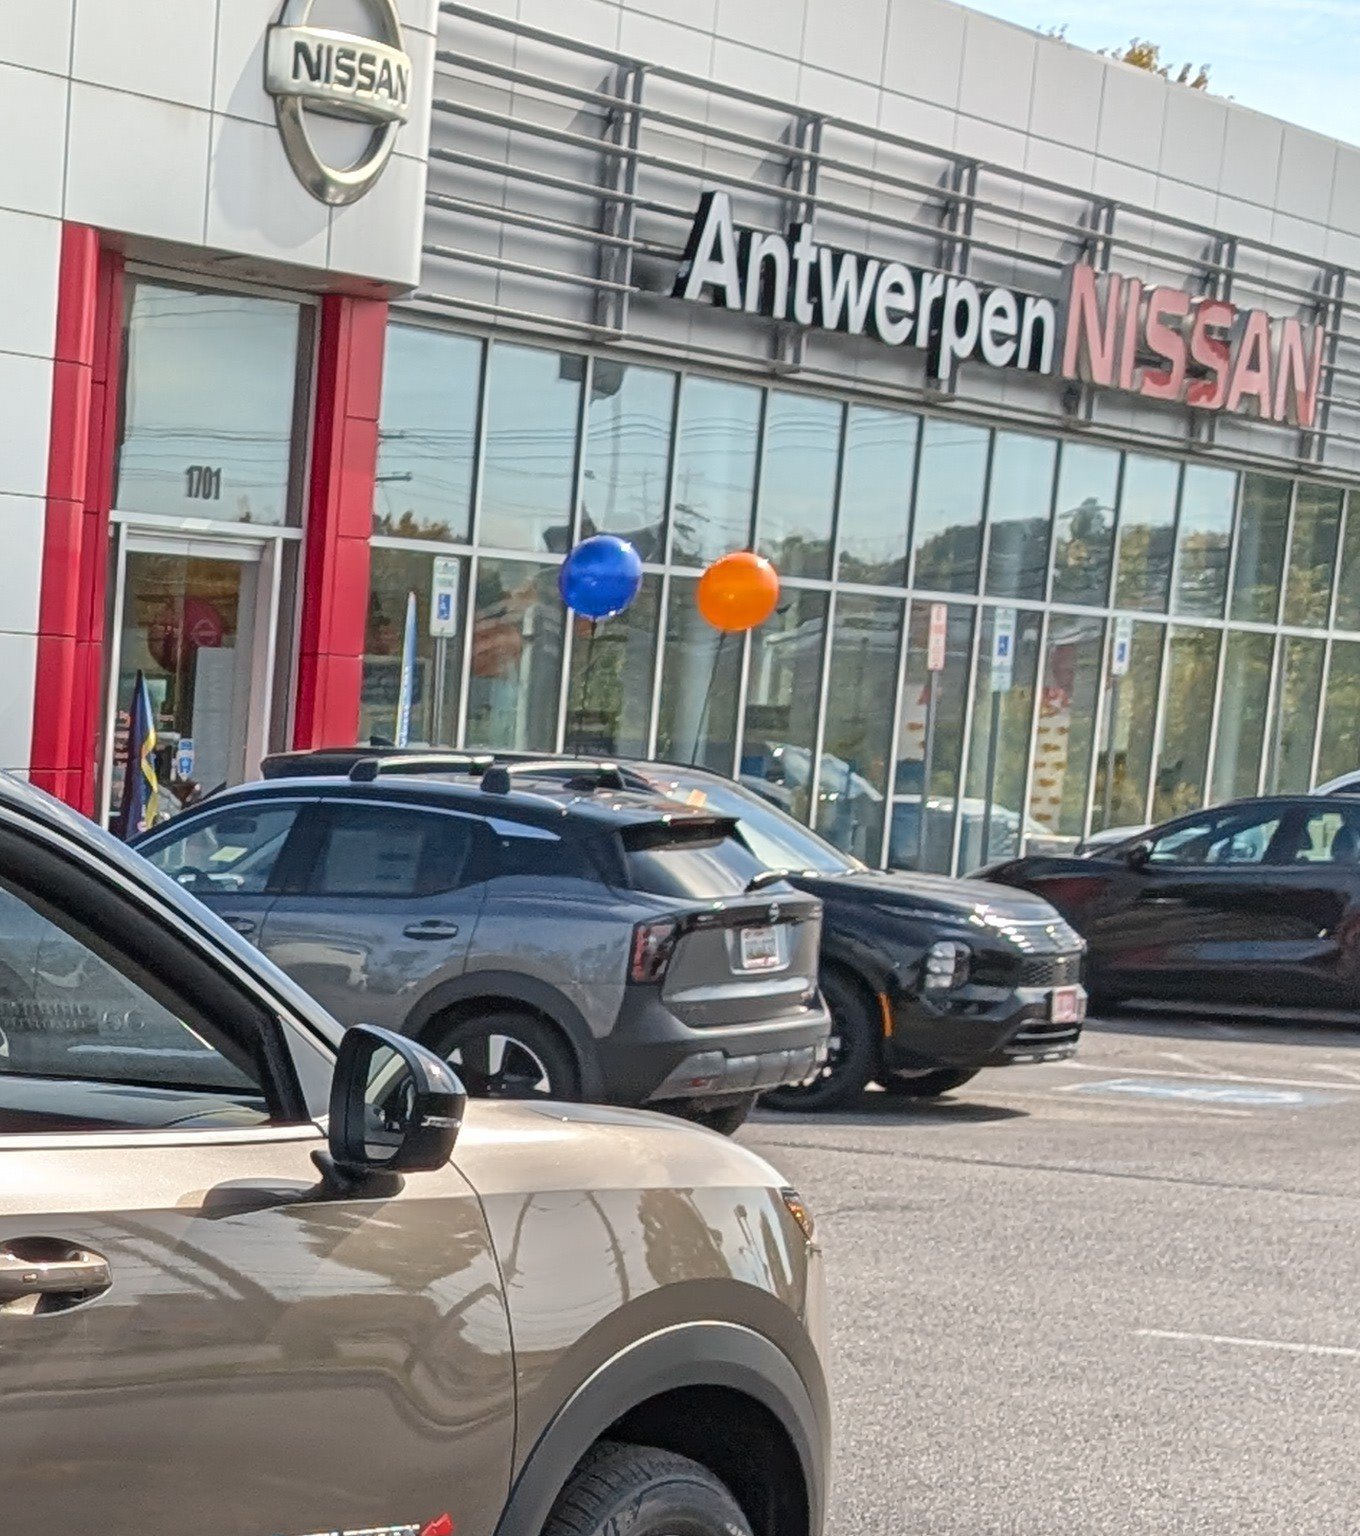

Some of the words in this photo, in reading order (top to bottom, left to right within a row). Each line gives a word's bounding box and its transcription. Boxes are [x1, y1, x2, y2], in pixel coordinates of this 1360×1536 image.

[292, 41, 409, 105] NISSAN
[683, 191, 1055, 380] Antwerpen
[1062, 264, 1323, 427] NISSAN
[185, 465, 222, 500] 1701
